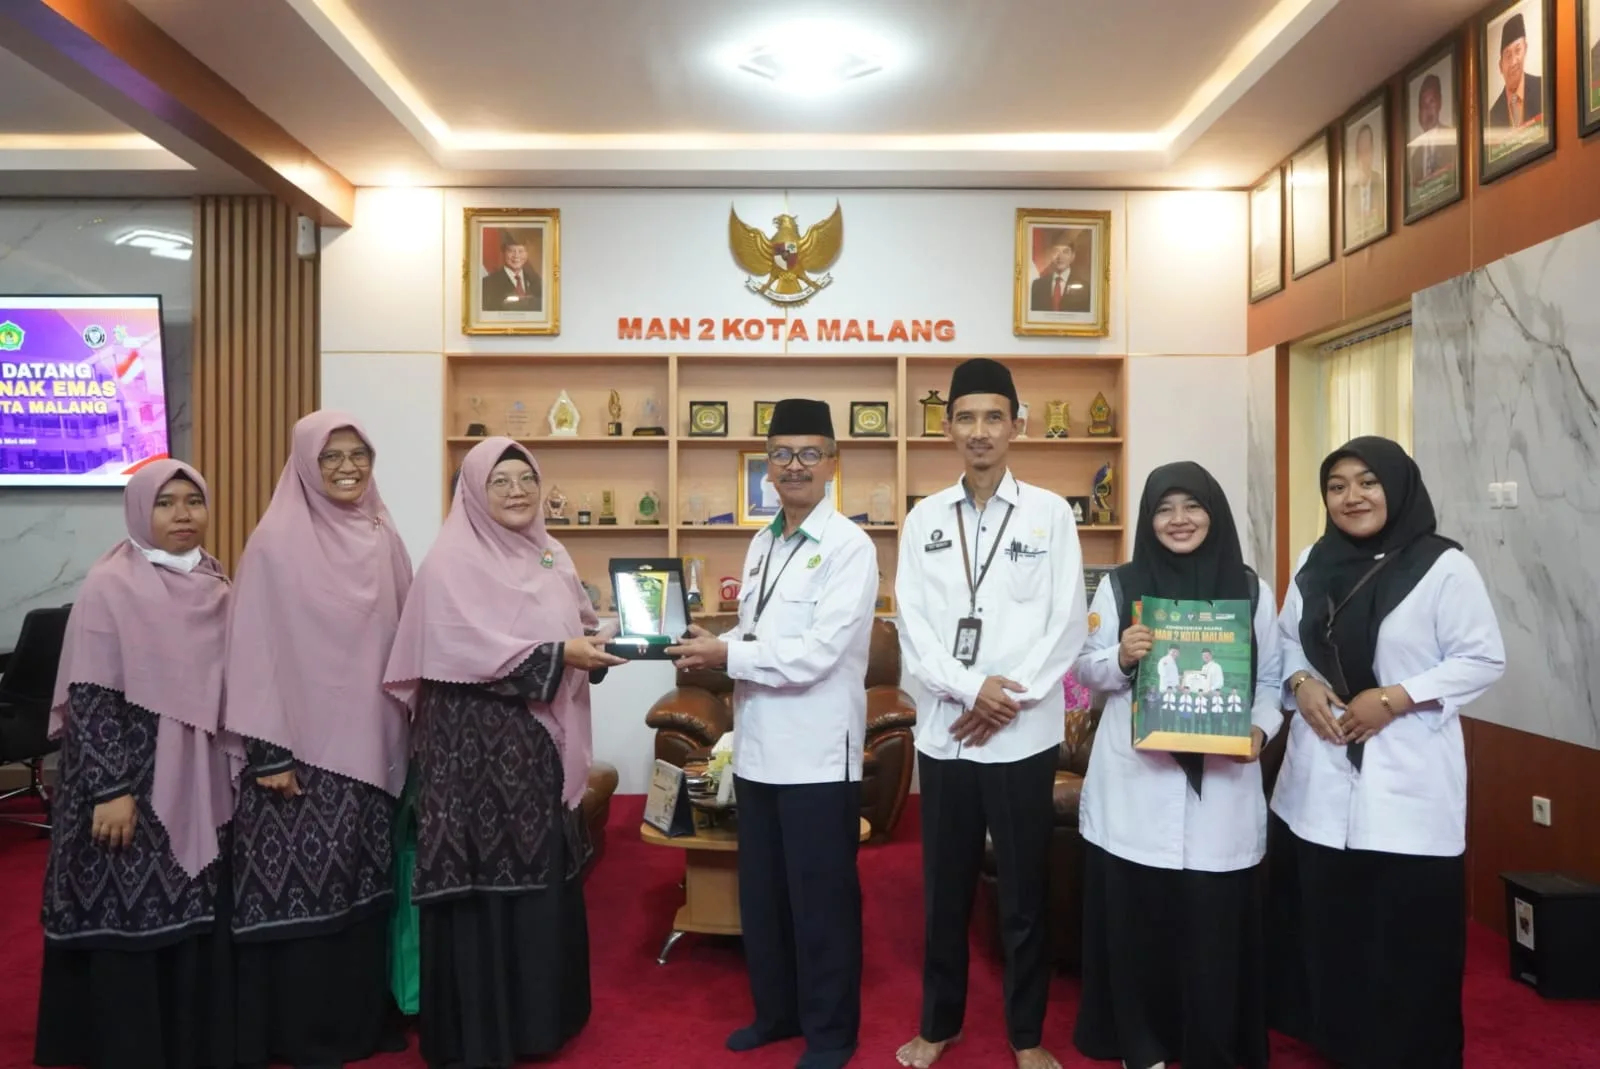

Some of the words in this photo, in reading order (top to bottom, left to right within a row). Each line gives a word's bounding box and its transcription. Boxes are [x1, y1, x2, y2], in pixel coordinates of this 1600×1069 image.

[618, 317, 691, 340] MAN
[698, 318, 715, 340] 2
[723, 317, 810, 342] KOTA
[817, 319, 956, 343] MALANG
[2, 362, 93, 379] DATANG
[52, 380, 117, 398] EMAS
[29, 400, 108, 415] MALANG
